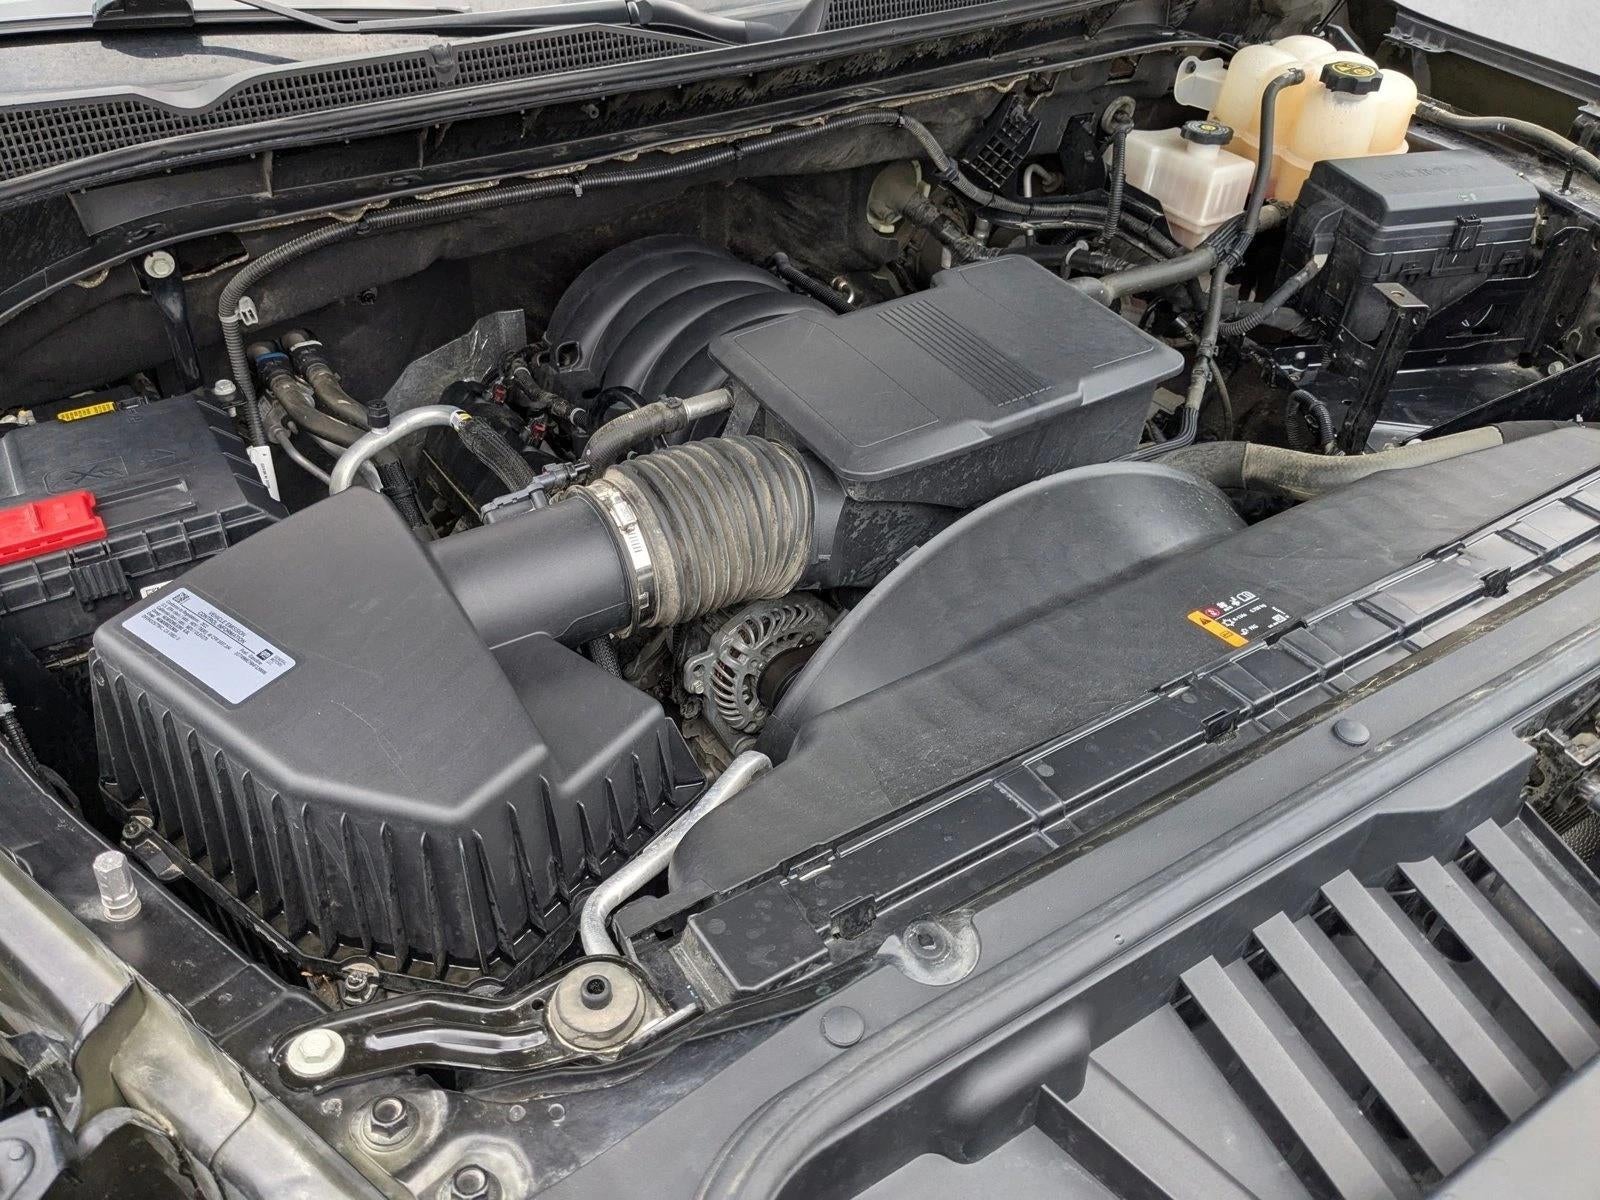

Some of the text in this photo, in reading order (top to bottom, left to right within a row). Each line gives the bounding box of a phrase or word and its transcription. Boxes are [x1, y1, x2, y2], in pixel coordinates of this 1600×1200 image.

[196, 610, 218, 625] CONTROL
[215, 622, 247, 644] INFORMATION
[223, 621, 248, 638] EMISSION
